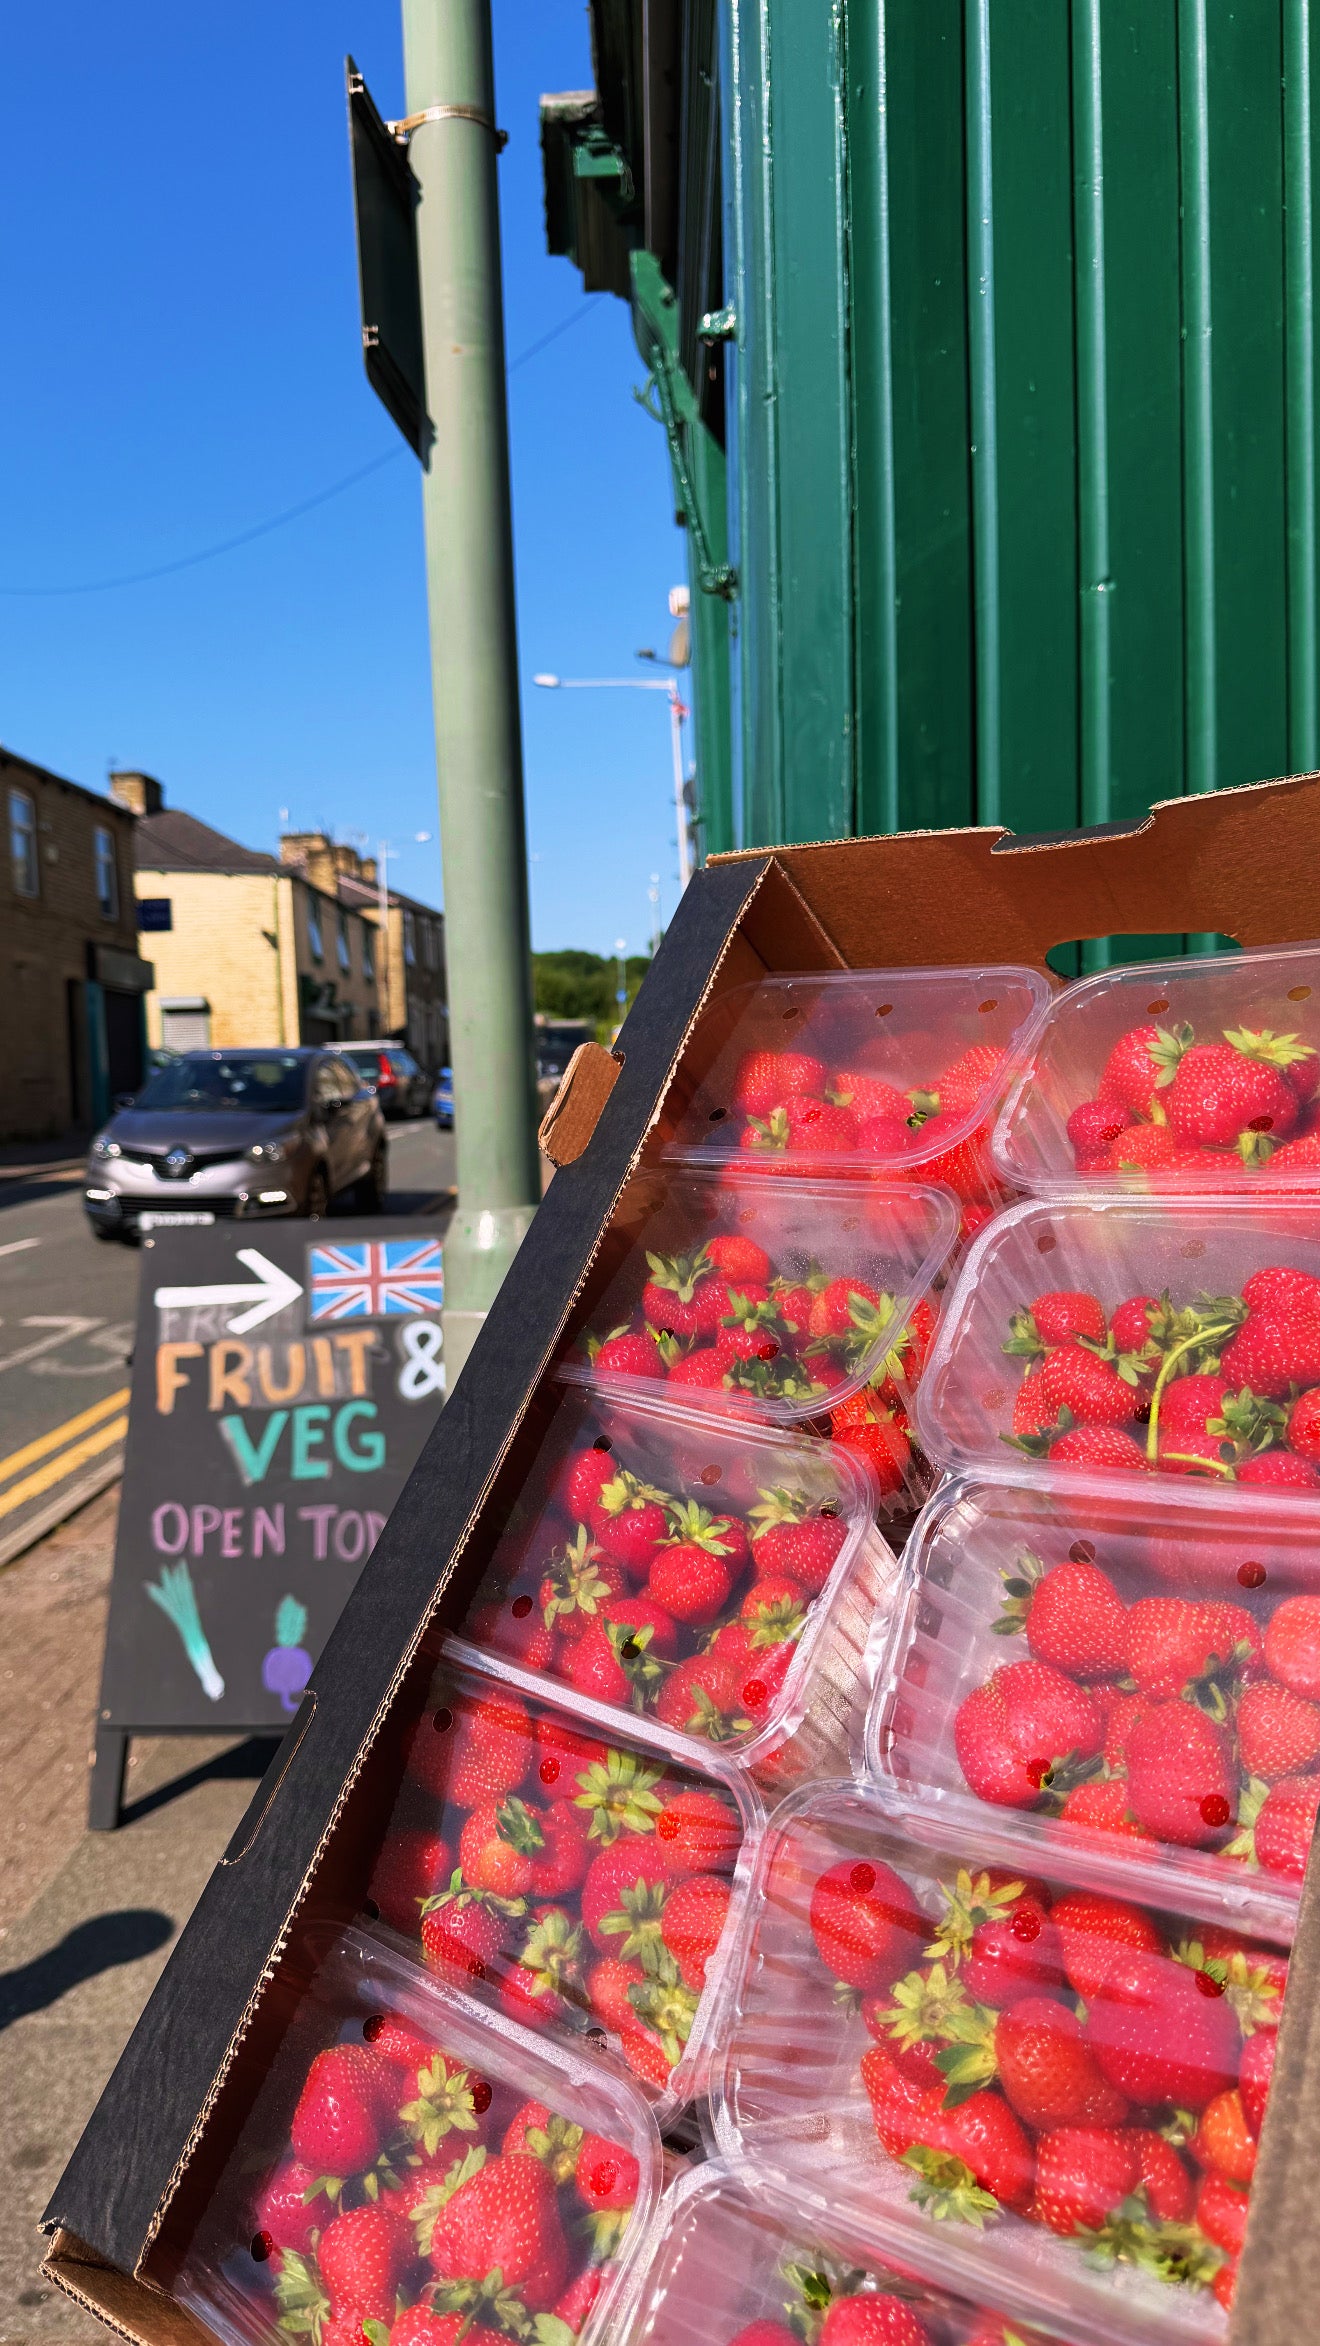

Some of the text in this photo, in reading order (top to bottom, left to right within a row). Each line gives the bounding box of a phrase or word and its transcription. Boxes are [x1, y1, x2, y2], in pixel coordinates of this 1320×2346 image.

[156, 1320, 445, 1415] FRUIT &
[222, 1400, 385, 1483] VEG
[151, 1502, 285, 1558] OPEN
